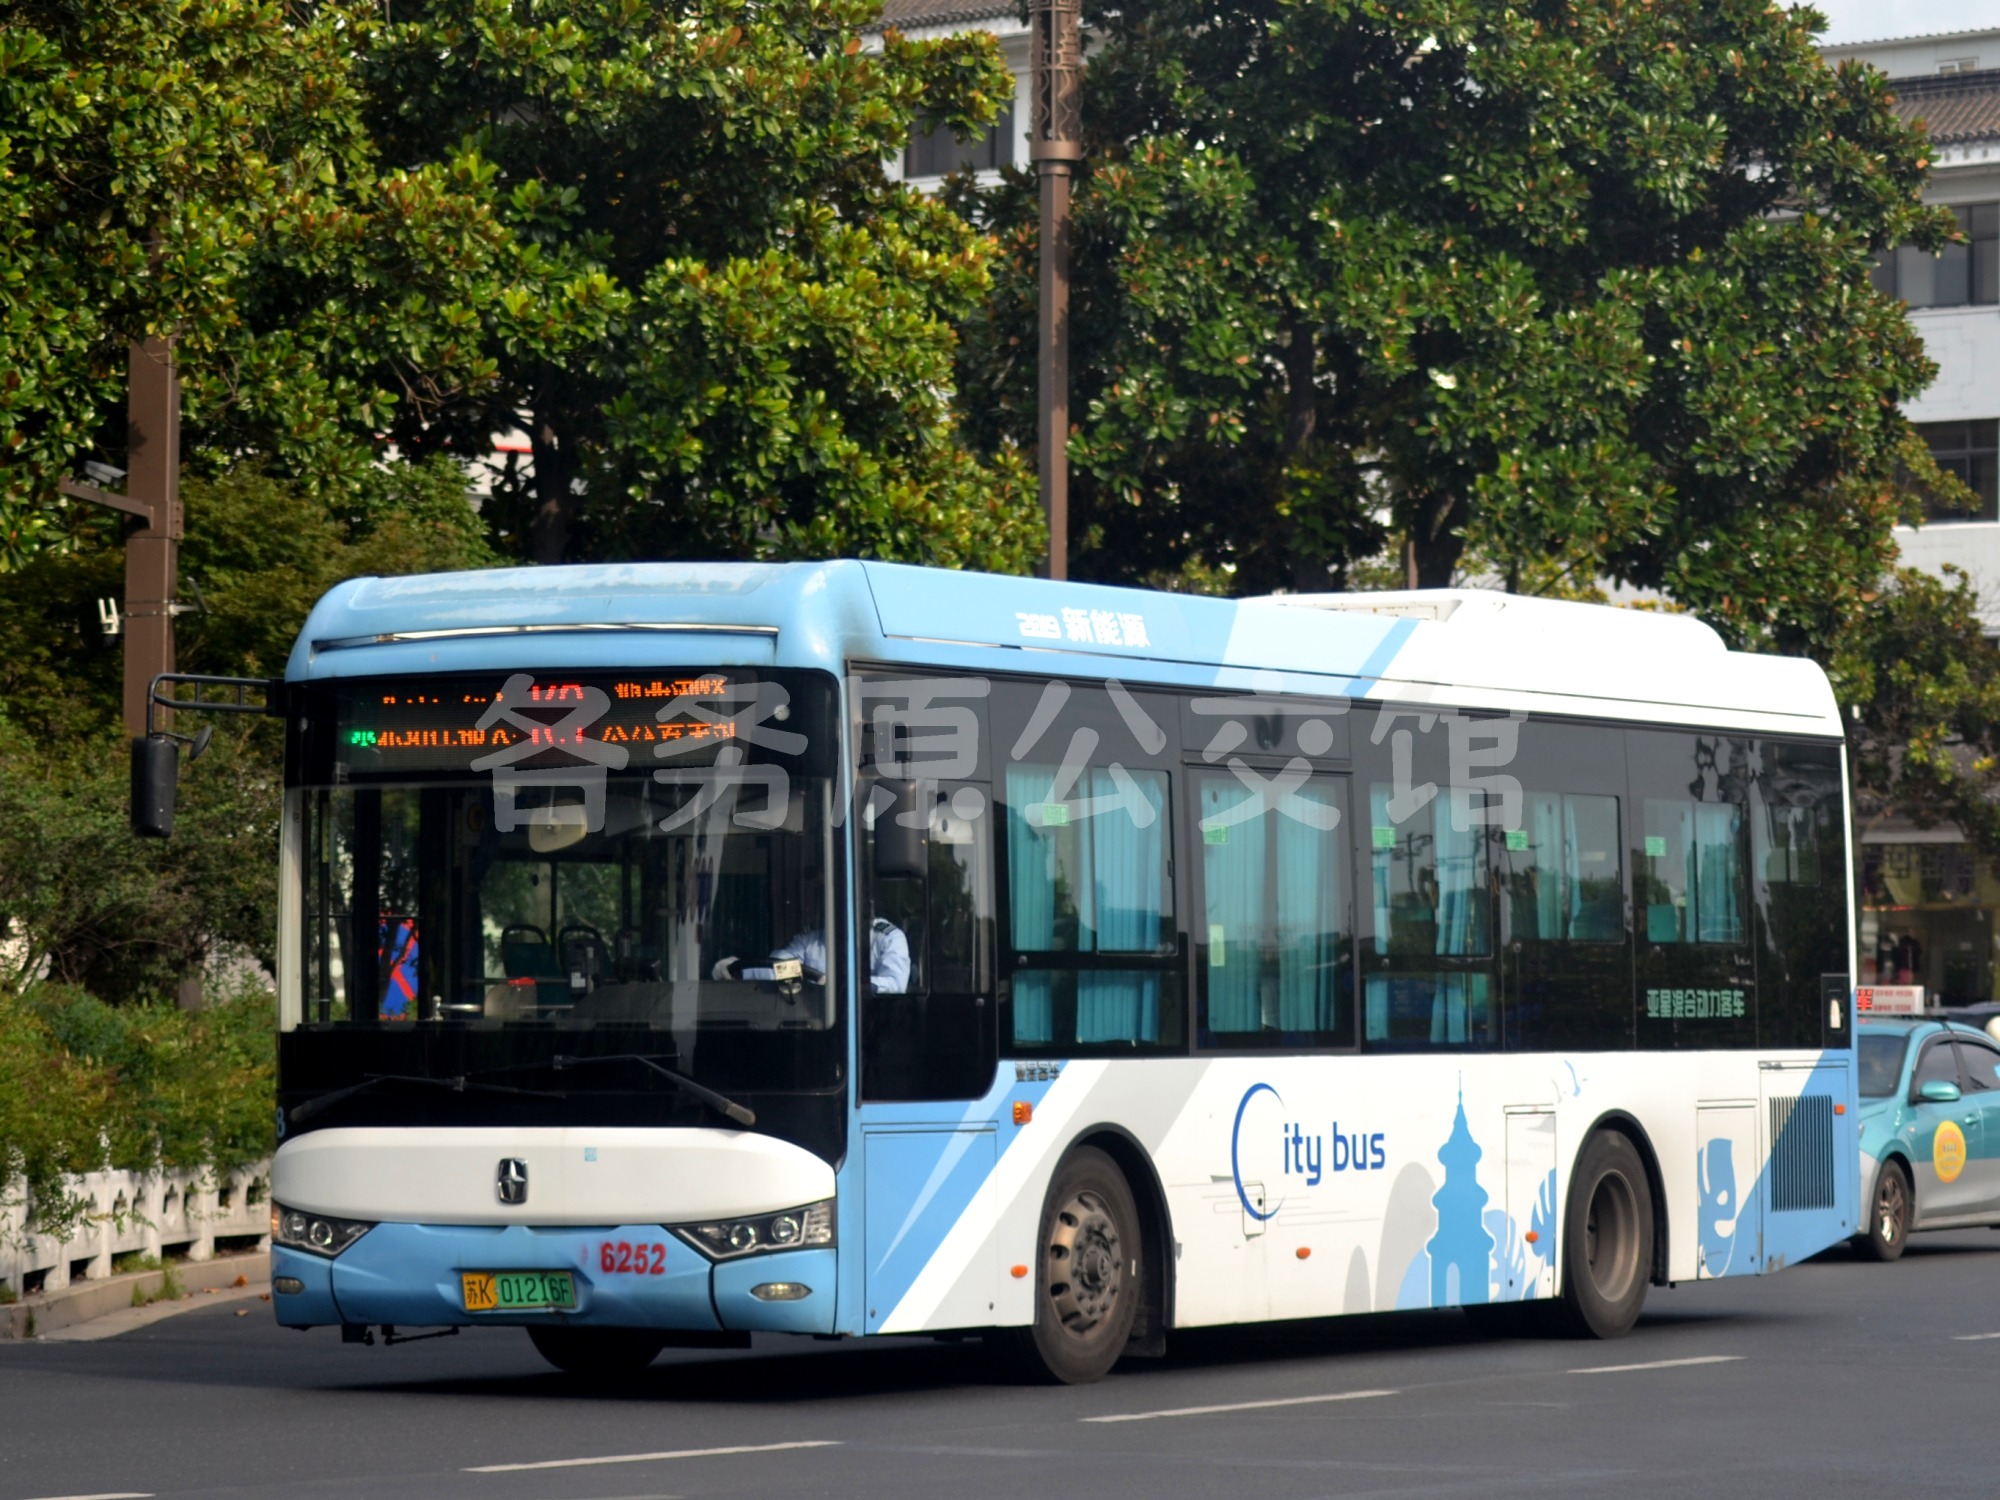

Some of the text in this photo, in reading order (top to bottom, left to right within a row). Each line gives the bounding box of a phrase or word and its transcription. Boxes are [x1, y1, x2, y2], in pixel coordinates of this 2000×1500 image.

[1231, 1082, 1386, 1221] City bus
[601, 1241, 666, 1274] 6252
